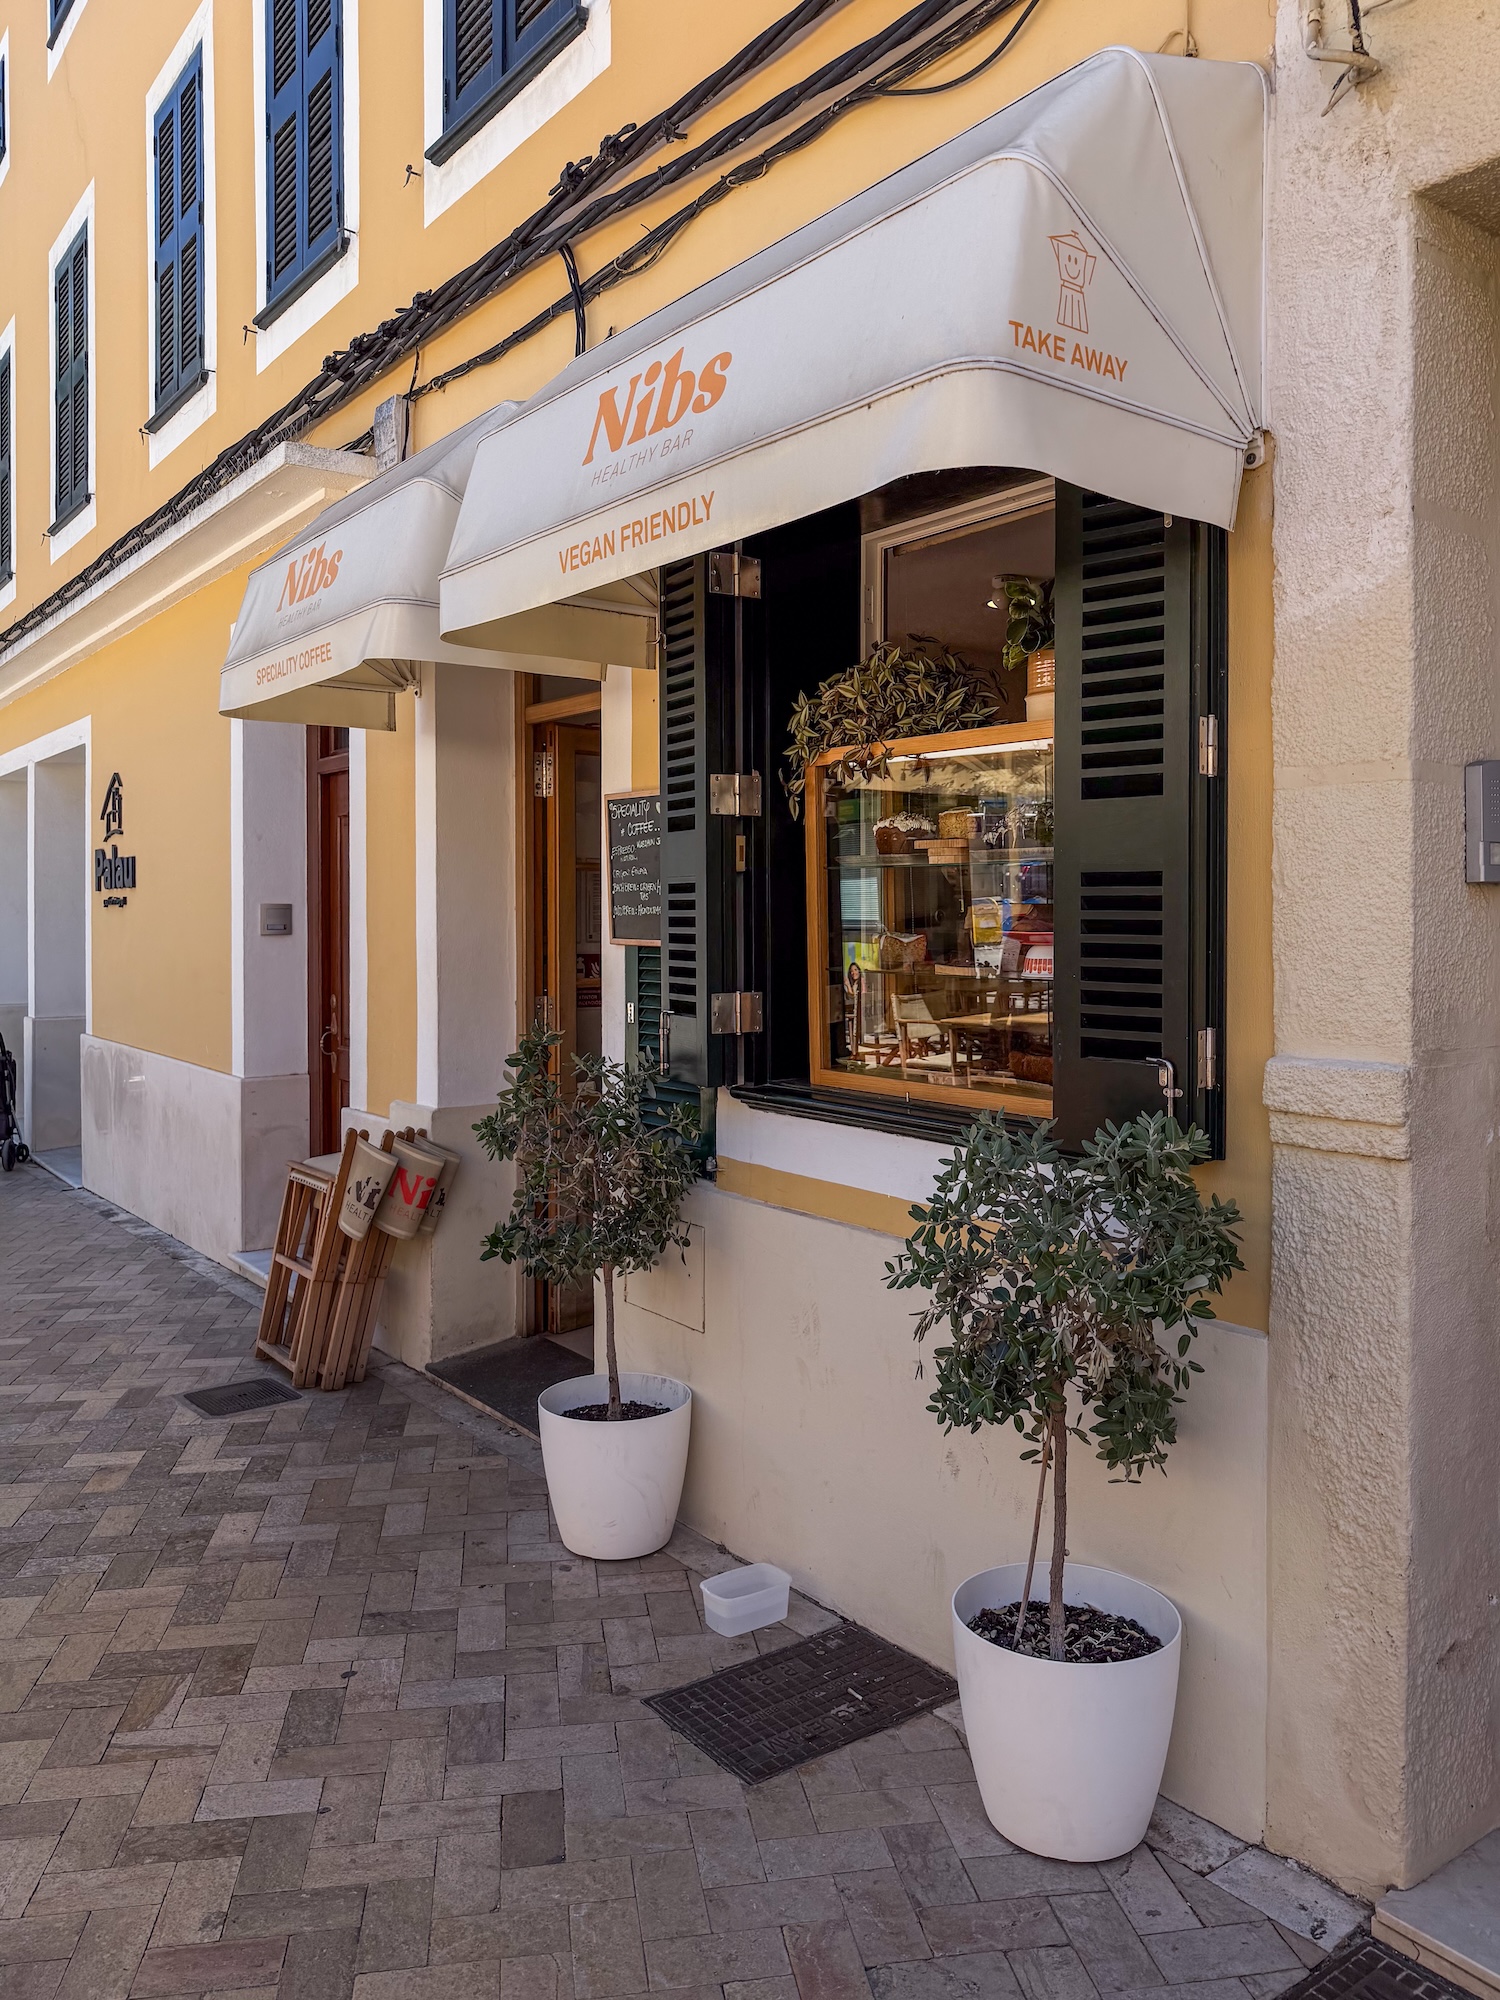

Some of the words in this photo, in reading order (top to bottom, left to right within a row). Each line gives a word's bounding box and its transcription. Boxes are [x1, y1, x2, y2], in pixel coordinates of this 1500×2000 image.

[1008, 320, 1066, 362] TAKE
[1071, 343, 1128, 382] AWAY
[582, 346, 733, 467] Nibs
[591, 443, 658, 487] HEALTHY
[661, 428, 694, 457] BAR
[558, 530, 616, 574] VEGAN
[620, 491, 715, 553] FRIENDLY
[276, 541, 343, 612] Nibs
[278, 608, 307, 628] HEALTHY
[307, 598, 322, 615] BAR
[256, 655, 298, 686] SPECIALITY
[299, 642, 332, 671] COFFEE
[95, 844, 136, 891] Palau
[347, 1176, 382, 1210] Ni
[388, 1167, 436, 1209] Ni
[389, 1204, 423, 1221] HEALT
